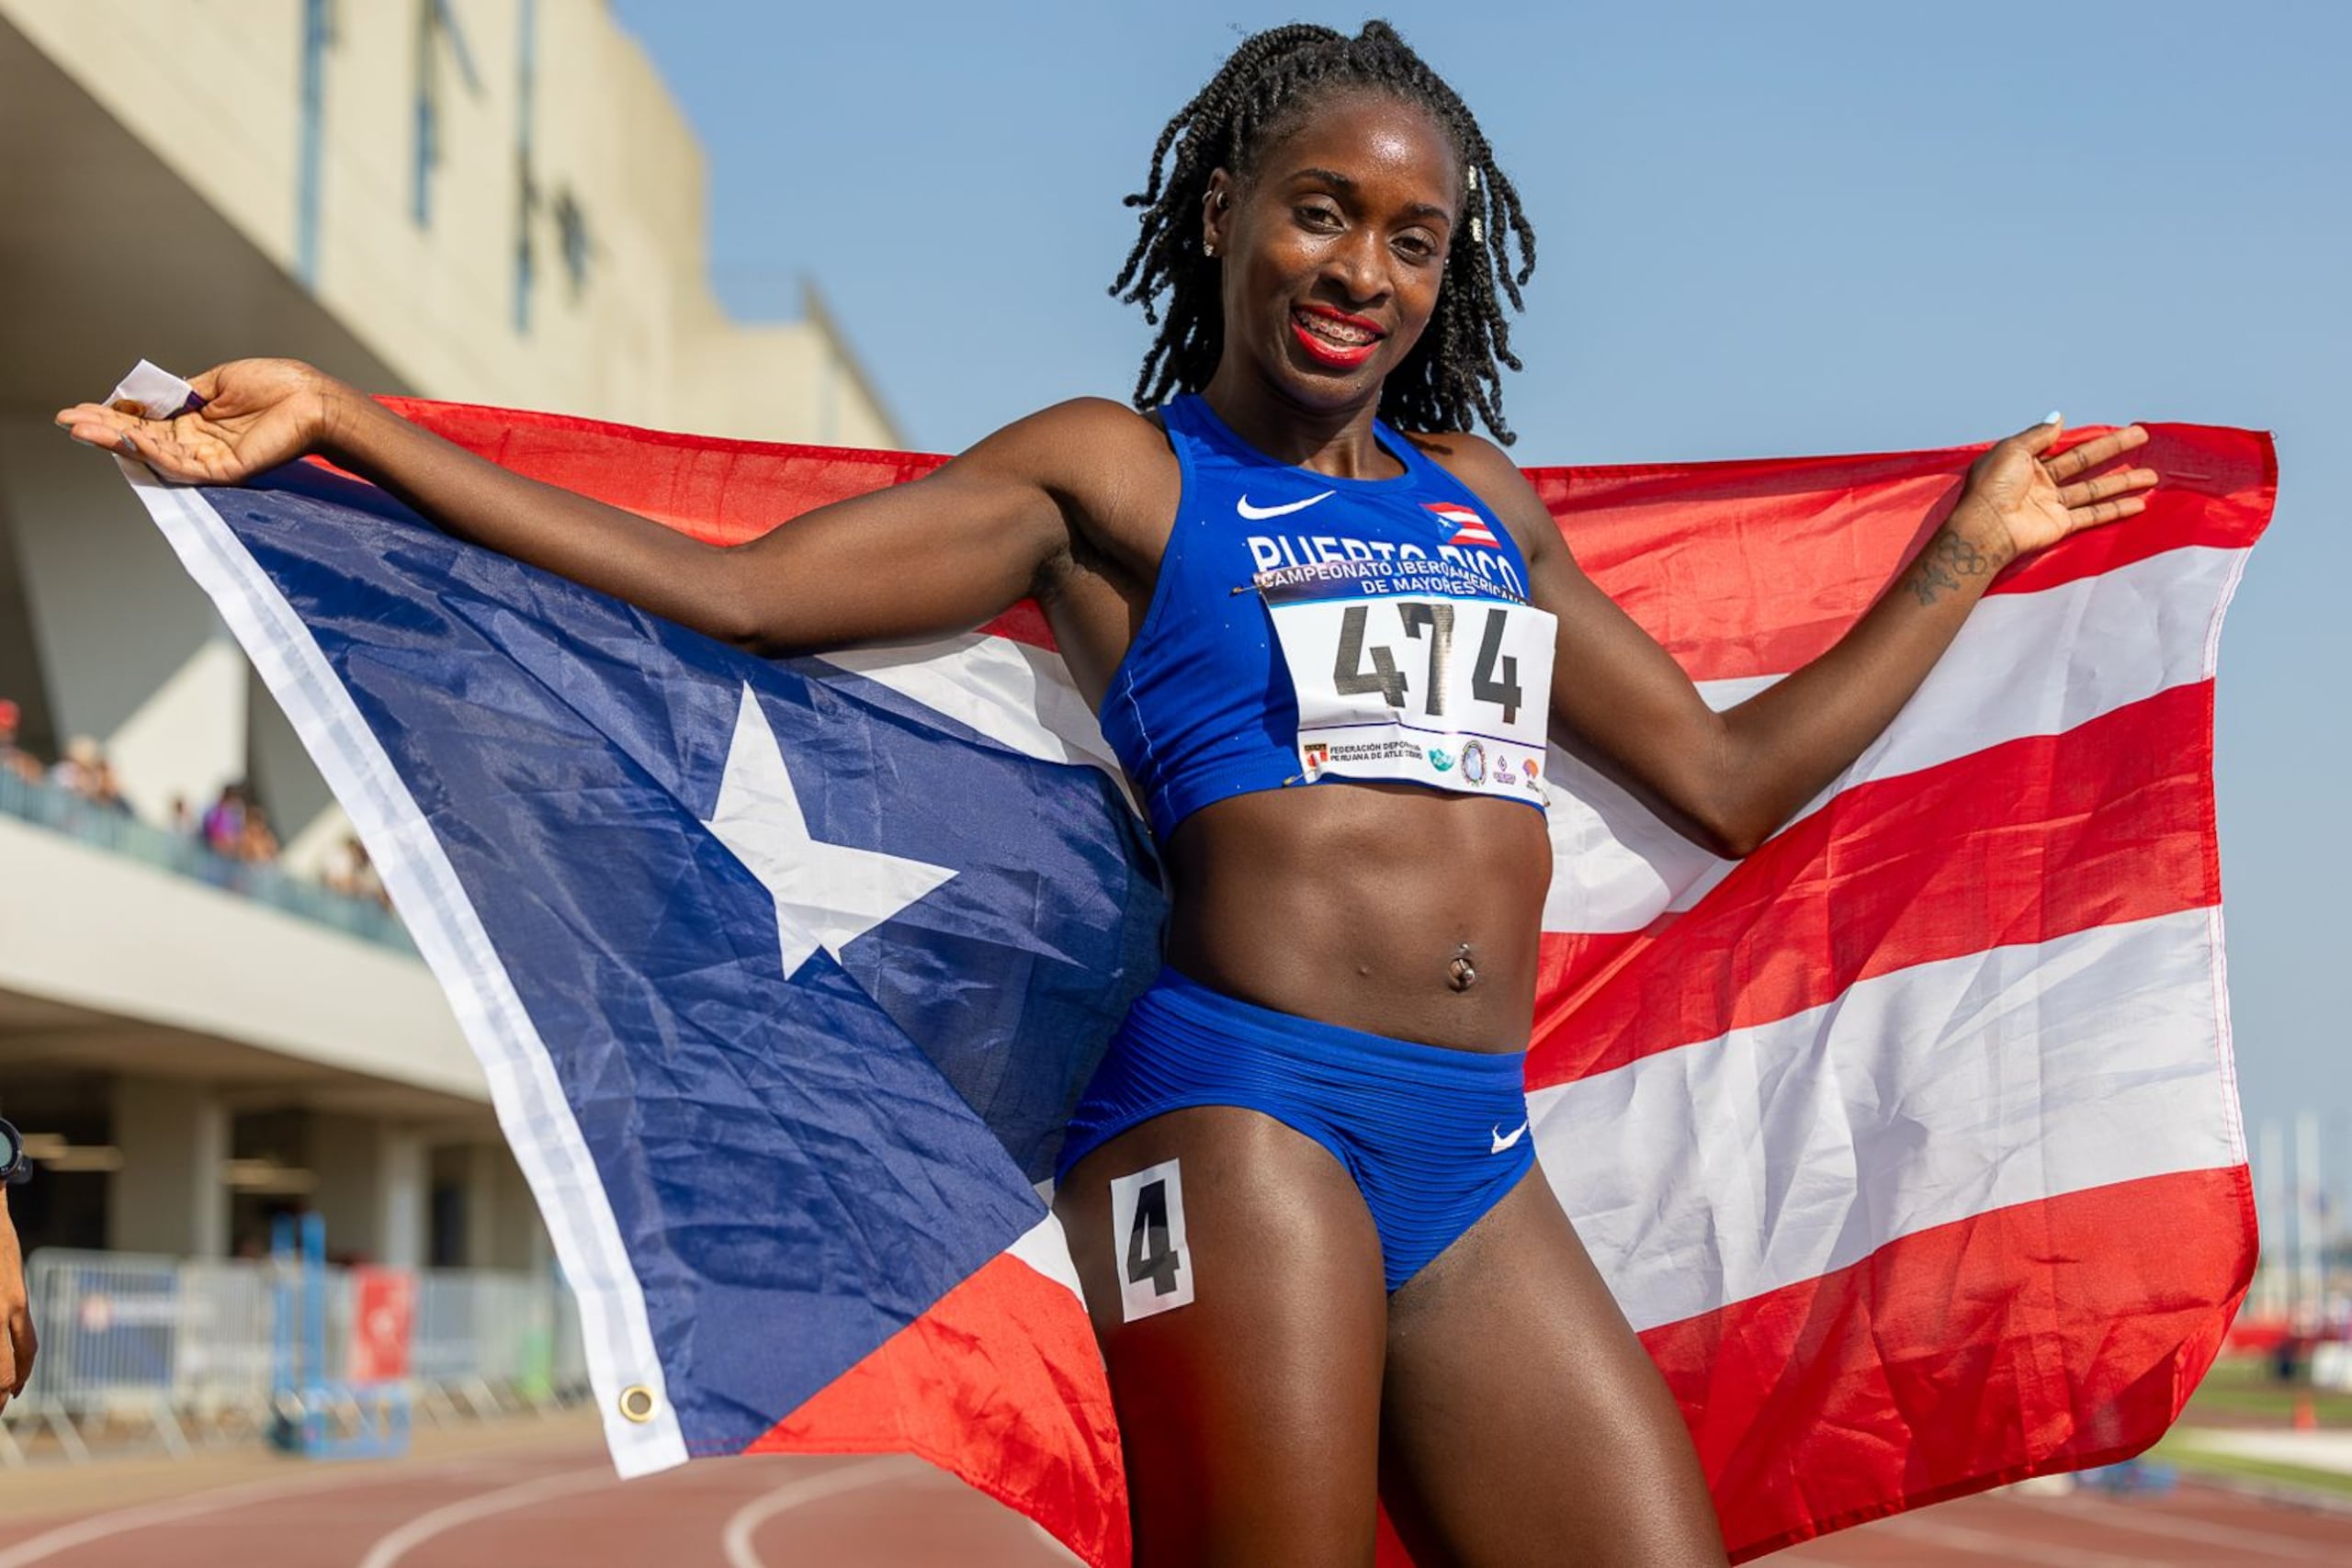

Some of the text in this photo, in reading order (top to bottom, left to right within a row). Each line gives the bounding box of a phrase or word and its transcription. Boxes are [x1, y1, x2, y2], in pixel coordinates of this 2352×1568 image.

[1260, 561, 1392, 588] CAMPEONATO
[1362, 577, 1476, 595] DE MAYORES
[1333, 603, 1521, 725] 474
[1371, 751, 1382, 760] DE
[1126, 1179, 1180, 1297] 4
